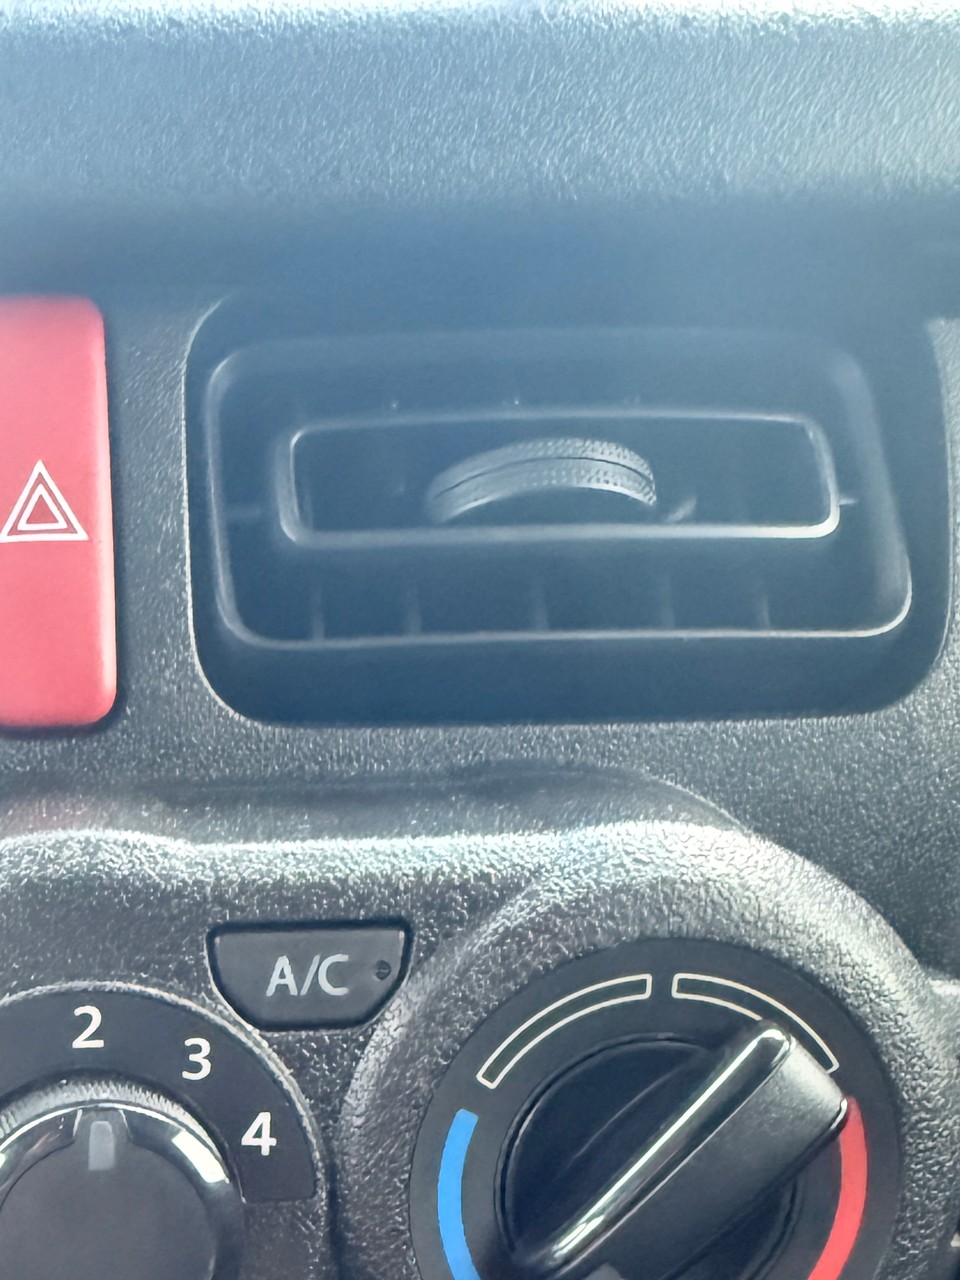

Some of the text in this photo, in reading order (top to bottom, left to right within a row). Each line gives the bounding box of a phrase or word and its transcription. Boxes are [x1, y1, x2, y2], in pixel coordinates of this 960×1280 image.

[266, 954, 349, 997] A/C
[71, 1005, 105, 1049] 2
[181, 1036, 213, 1081] 3
[241, 1111, 277, 1156] 4
